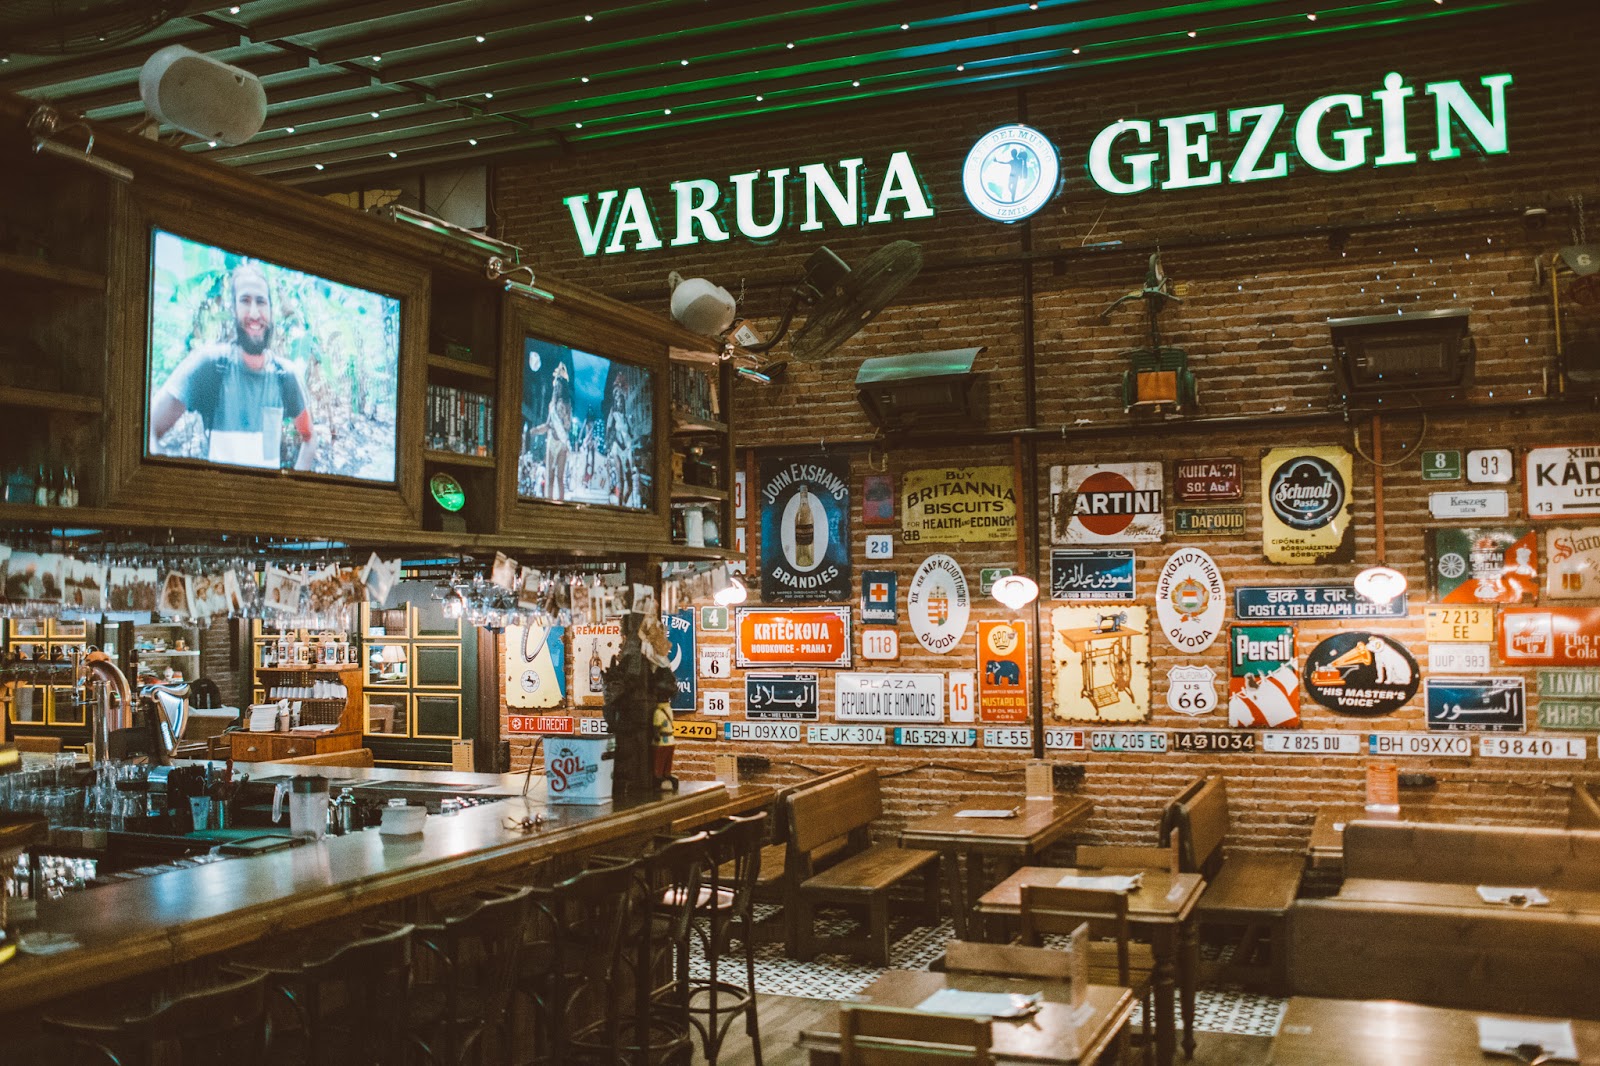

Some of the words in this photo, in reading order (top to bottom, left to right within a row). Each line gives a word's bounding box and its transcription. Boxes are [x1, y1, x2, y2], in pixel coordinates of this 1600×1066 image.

[992, 130, 1015, 143] DEL
[563, 151, 934, 257] VARUNA
[1089, 72, 1513, 194] GEZGİN
[1435, 452, 1447, 469] 8
[1481, 456, 1499, 475] 93
[945, 471, 974, 480] BUY
[762, 470, 792, 505] JOHN
[790, 463, 849, 501] EXSHAWS
[907, 482, 1016, 509] BRITANNIA
[1275, 482, 1333, 502] Schmoll
[924, 501, 1004, 514] BISCUITS
[1450, 496, 1488, 508] Keszeg
[1536, 502, 1553, 512] 13
[923, 518, 961, 529] HEALTH
[871, 541, 889, 553] 28
[771, 565, 838, 589] BRANDIES
[1265, 589, 1299, 603] डाक
[1304, 589, 1317, 602] व
[1248, 605, 1276, 616] POST
[1277, 605, 1287, 616] &
[1288, 604, 1351, 616] TELEGRAPH
[1355, 603, 1394, 615] OFFICE
[708, 610, 719, 627] 4
[1442, 610, 1449, 624] Z
[1454, 610, 1479, 624] 213
[576, 626, 620, 635] REMMER
[754, 620, 830, 641] KRTEČKOVA
[1170, 627, 1213, 647] ÓVODA
[1453, 626, 1469, 639] EE
[869, 636, 891, 653] 118
[921, 632, 957, 648] ÓVODA
[1561, 632, 1590, 646] The
[801, 644, 826, 653] PRAHA
[827, 644, 833, 653] 7
[1236, 634, 1290, 665] Persil
[1565, 645, 1598, 659] Cola
[710, 660, 719, 675] 6
[1465, 655, 1485, 667] 983
[860, 679, 916, 688] PLAZA
[750, 684, 814, 708] الهلالي
[953, 683, 967, 711] 15
[1179, 692, 1207, 709] 66
[1345, 688, 1406, 700] MASTER'S
[709, 699, 724, 710] 58
[842, 692, 881, 714] REPUBLICA
[884, 692, 892, 715] DE
[895, 693, 936, 716] HONDURAS
[982, 697, 1015, 706] MUSTARD
[1015, 697, 1025, 706] OIL
[524, 718, 534, 730] FC
[537, 719, 568, 731] UTRECHT
[732, 725, 750, 737] BH
[820, 728, 882, 742] EJK-304
[997, 731, 1029, 745] E-55
[1093, 734, 1116, 748] CRX
[1121, 734, 1144, 748] 205
[1150, 735, 1166, 749] EC
[1283, 736, 1290, 749] Z
[1295, 736, 1319, 750] 825
[1324, 737, 1340, 750] DU
[1379, 736, 1403, 751] BH
[551, 756, 585, 792] SOL
